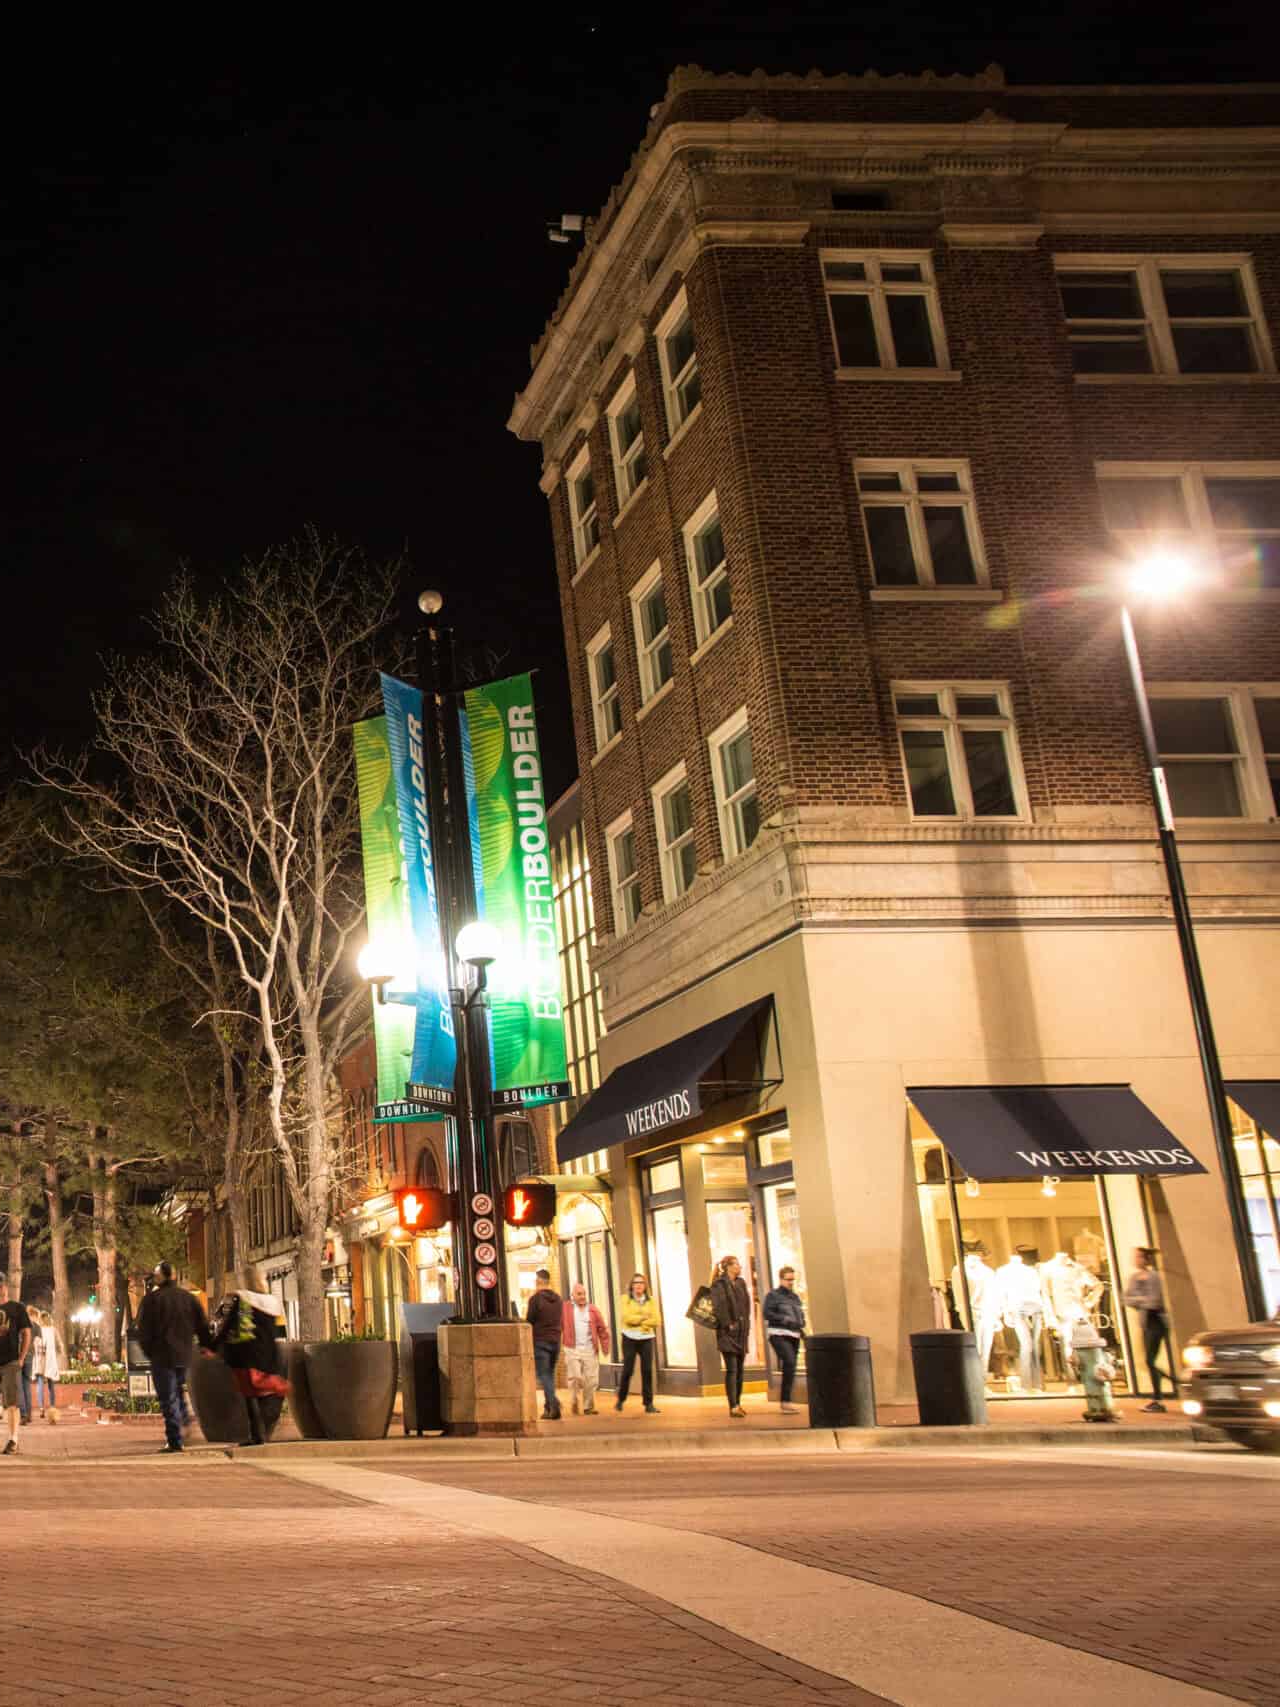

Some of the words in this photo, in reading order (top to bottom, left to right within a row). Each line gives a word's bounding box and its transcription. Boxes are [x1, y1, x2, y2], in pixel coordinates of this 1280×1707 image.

[508, 704, 561, 1019] BODERBOULDER
[413, 1086, 451, 1103] DOWNTOWN
[504, 1085, 559, 1103] BOULDER
[625, 1089, 690, 1136] WEEKENDS
[1016, 1149, 1195, 1167] WEEKENDS
